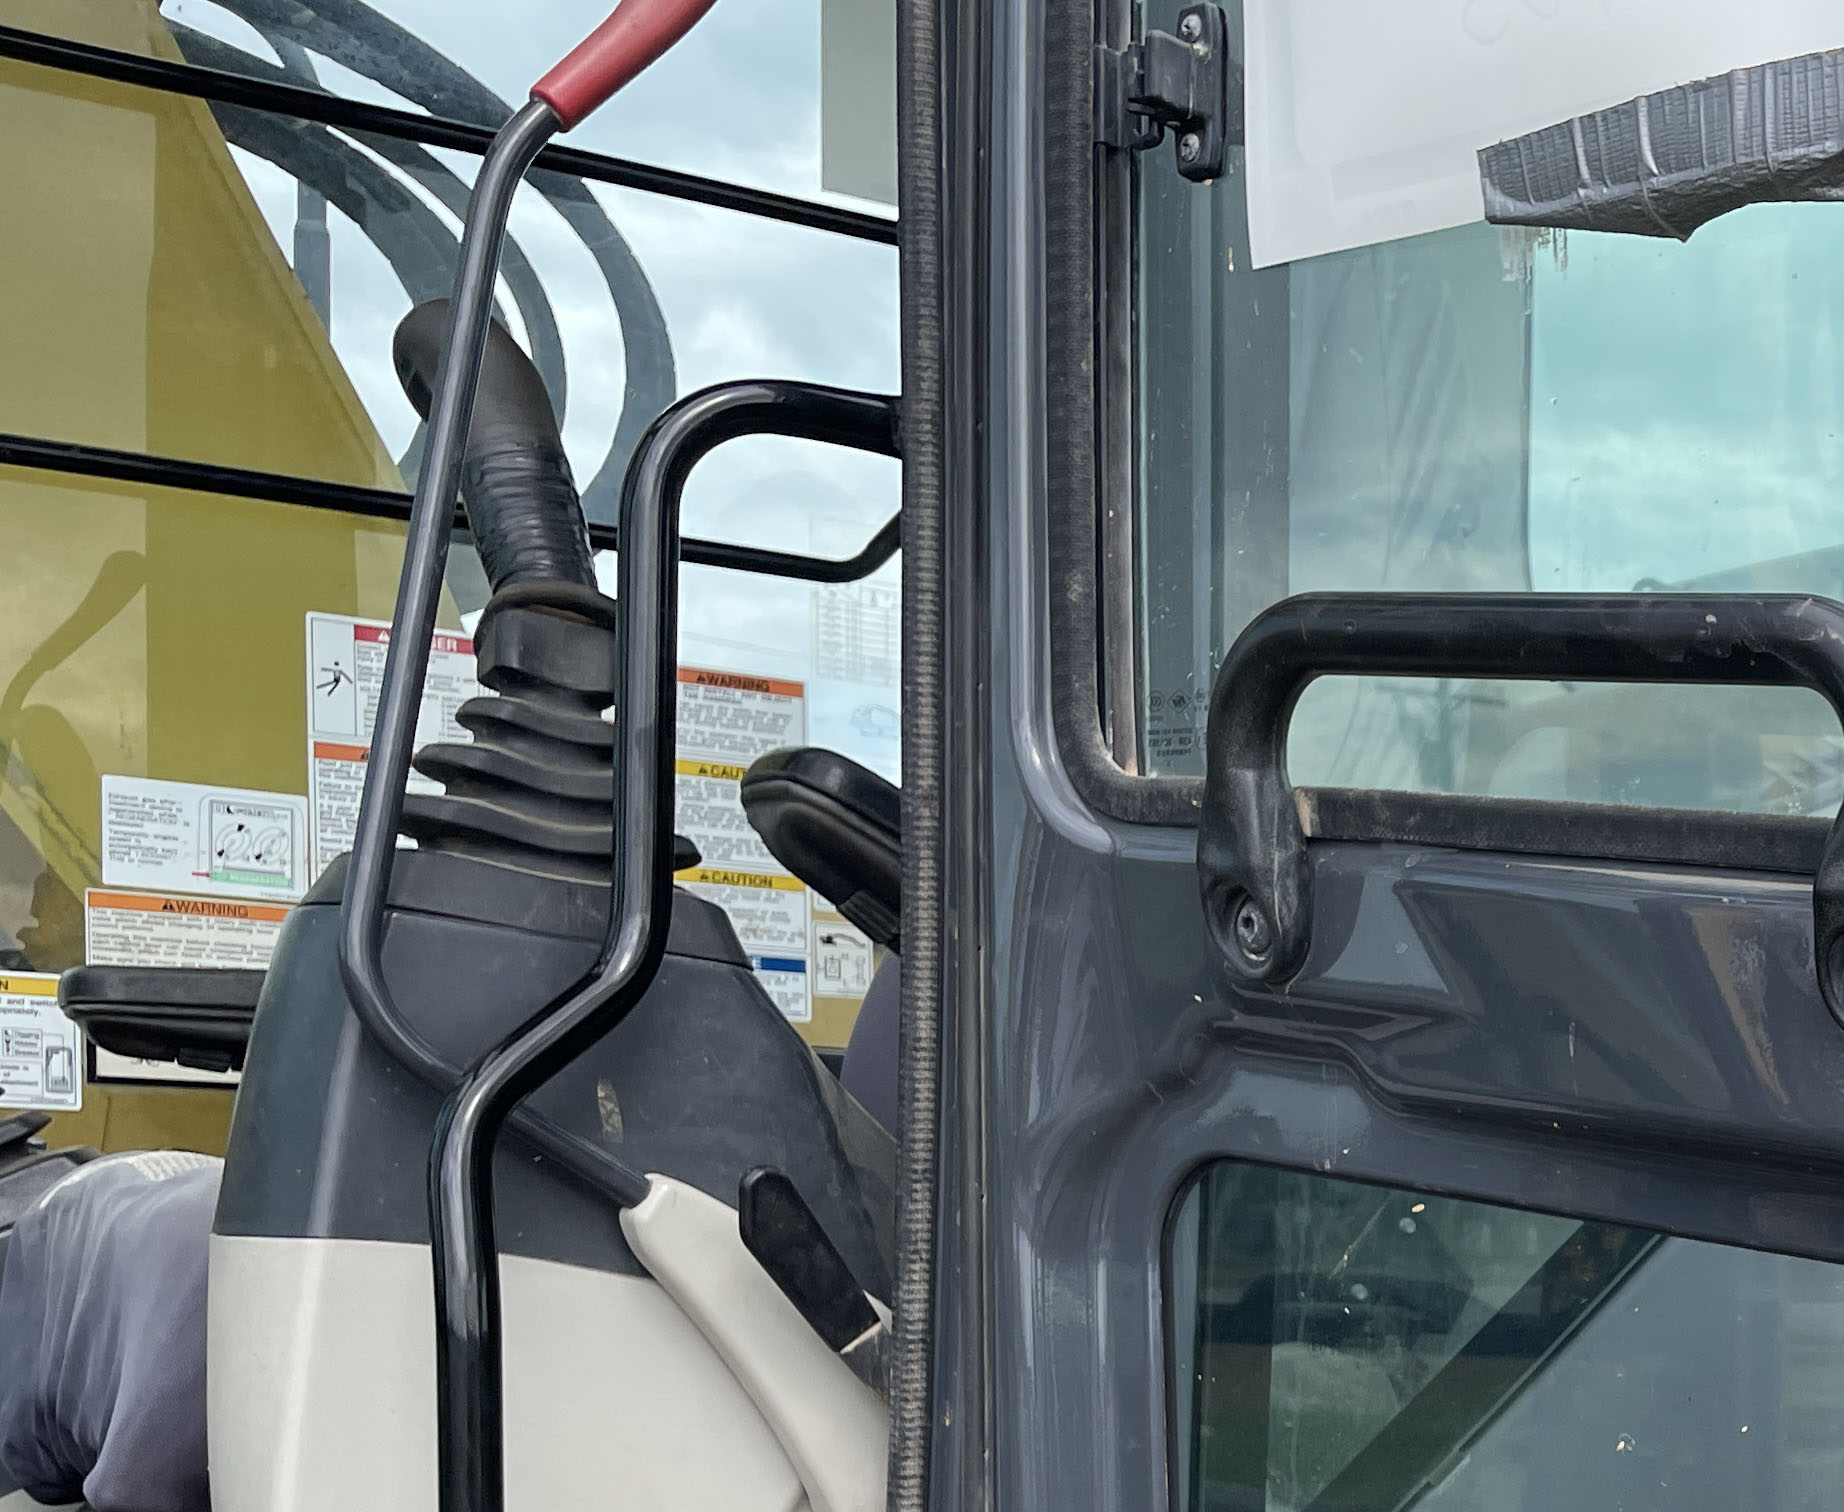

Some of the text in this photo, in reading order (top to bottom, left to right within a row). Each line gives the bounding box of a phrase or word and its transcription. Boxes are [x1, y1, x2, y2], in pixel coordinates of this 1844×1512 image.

[707, 672, 770, 692] WARNING
[712, 872, 773, 888] CAUTION
[175, 900, 249, 919] WARNING
